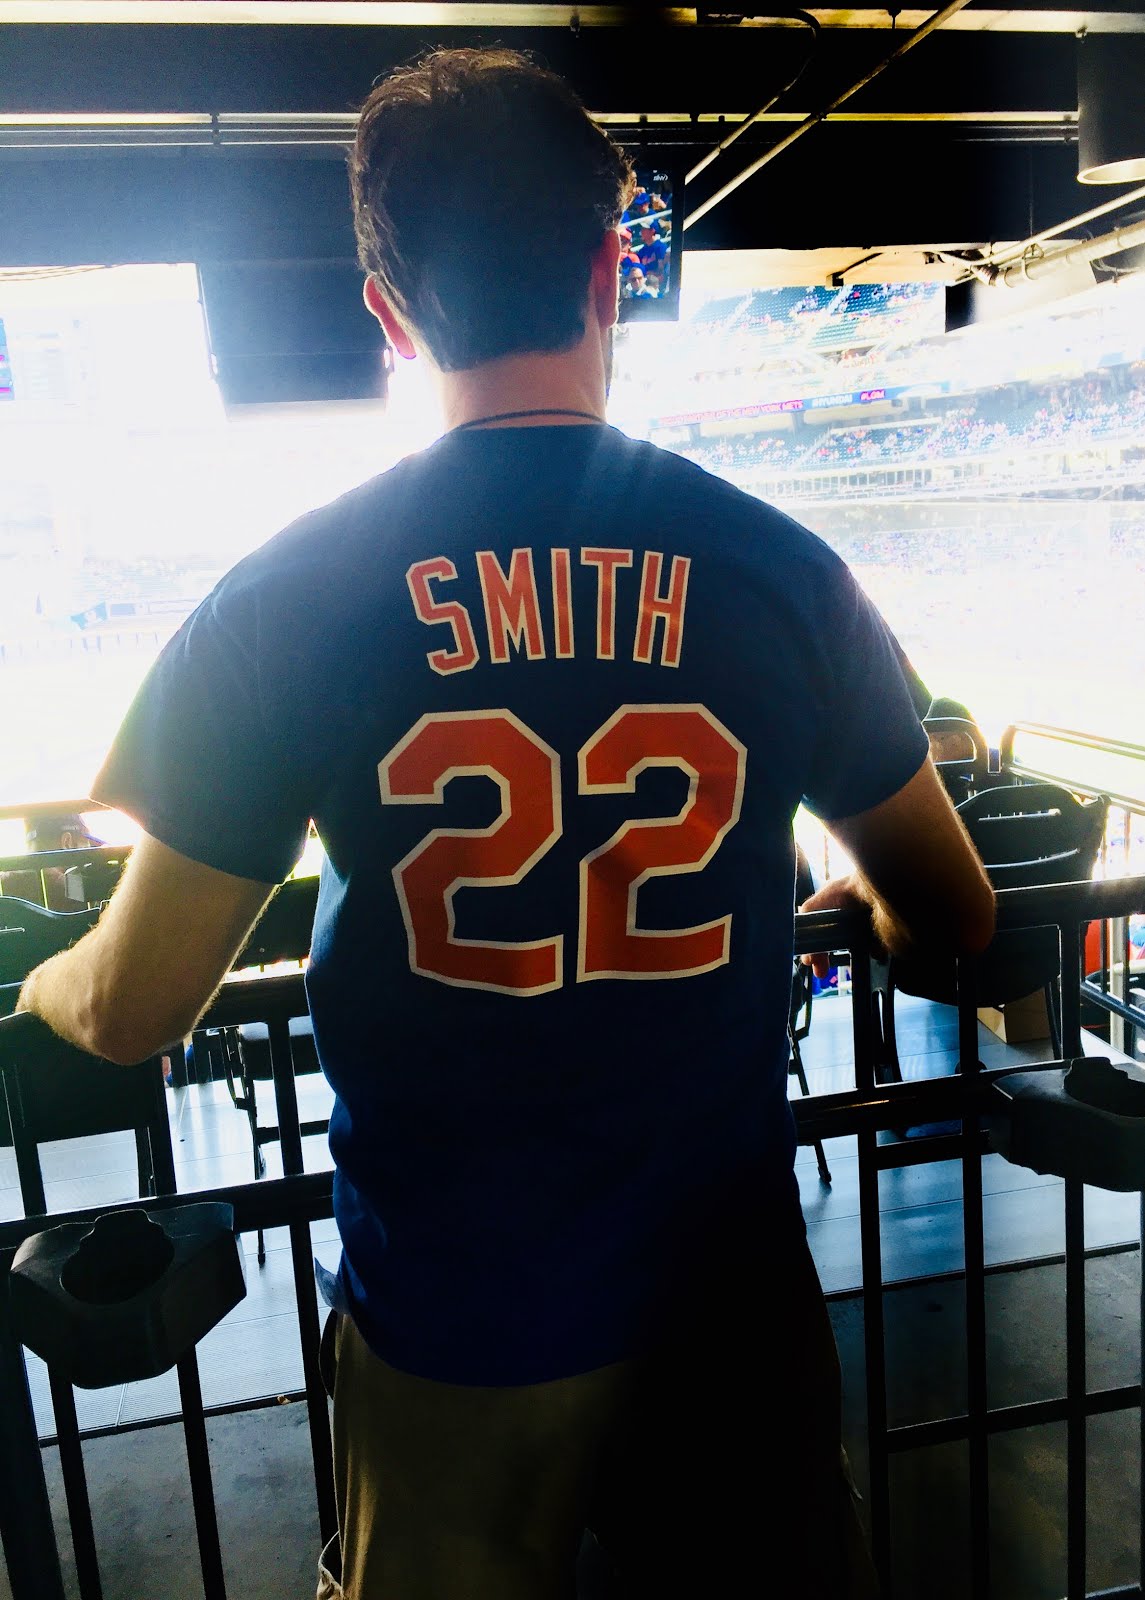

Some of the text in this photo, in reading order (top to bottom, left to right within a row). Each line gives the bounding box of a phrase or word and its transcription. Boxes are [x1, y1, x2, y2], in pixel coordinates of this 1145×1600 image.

[743, 405, 760, 416] NEW
[761, 402, 782, 413] YORK
[783, 399, 804, 411] METS
[406, 547, 691, 676] SMITH
[378, 703, 747, 997] 22
